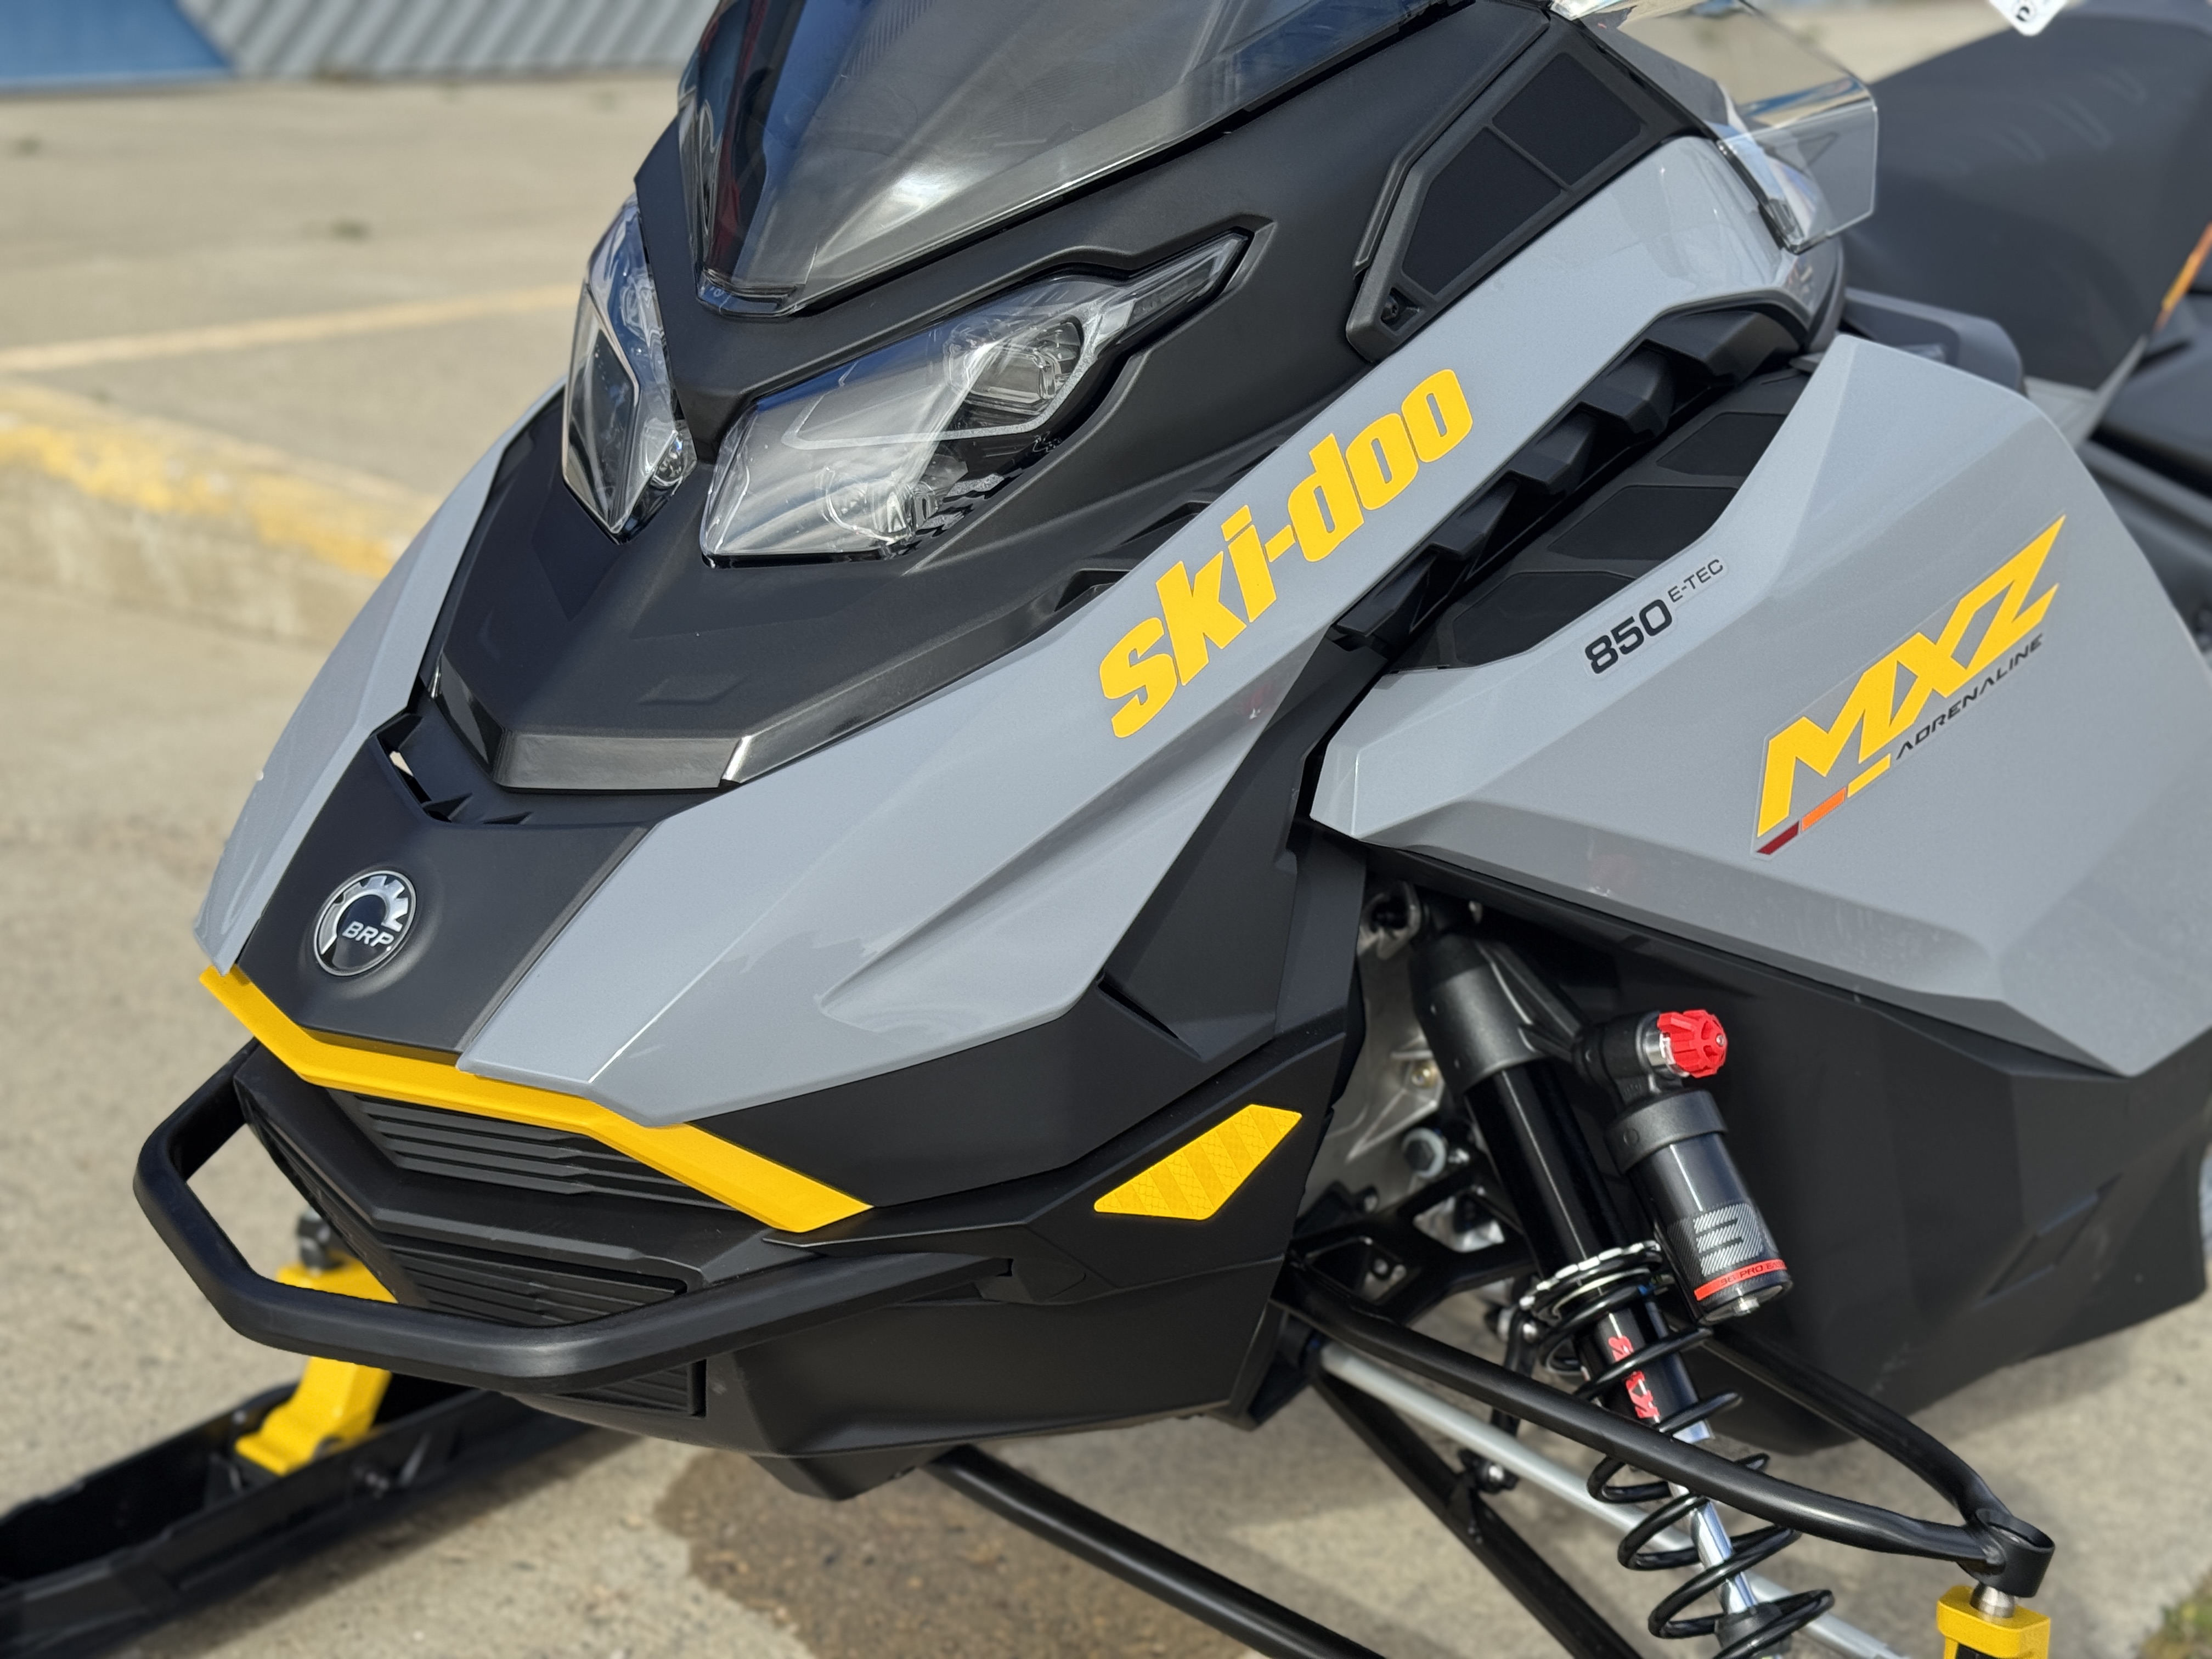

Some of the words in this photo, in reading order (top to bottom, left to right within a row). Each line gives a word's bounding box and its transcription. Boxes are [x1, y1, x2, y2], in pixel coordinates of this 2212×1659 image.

[1099, 369, 1473, 738] ski-doo
[1584, 599, 1673, 674] 850
[1667, 558, 1723, 603] E-TEC
[1757, 515, 2066, 838] MXZ
[1896, 633, 2043, 760] ADRENALINE
[342, 921, 394, 947] BRP
[1739, 1265, 1763, 1278] PRO
